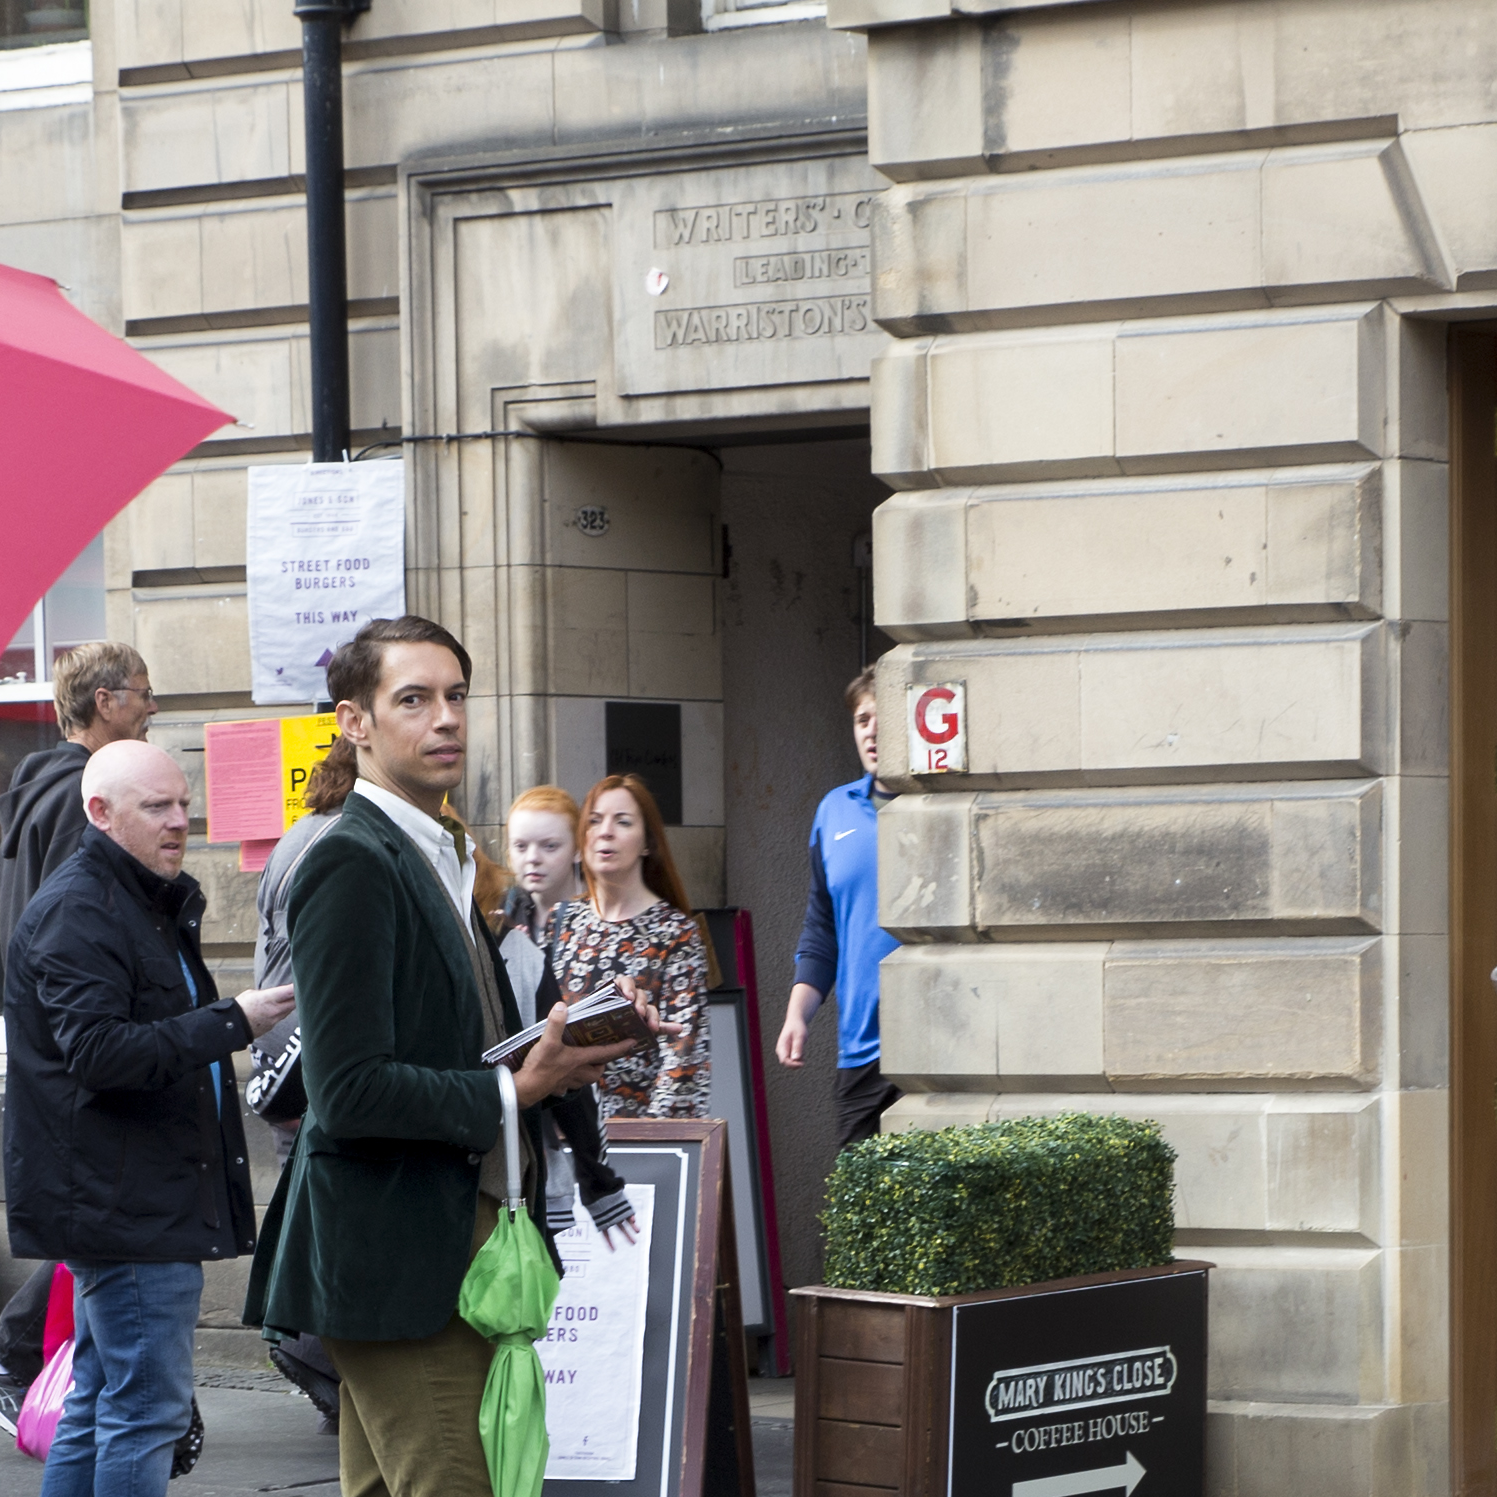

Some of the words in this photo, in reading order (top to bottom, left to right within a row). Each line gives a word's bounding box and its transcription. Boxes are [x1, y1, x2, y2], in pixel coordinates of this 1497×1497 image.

[740, 252, 848, 286] LEADING
[663, 299, 868, 347] WARRISTON'S
[581, 510, 605, 530] 323
[281, 560, 331, 573] STREET
[336, 558, 371, 571] FOOD
[295, 576, 356, 590] BURGERS
[295, 612, 325, 624] THIS
[330, 610, 358, 623] WAY
[915, 687, 959, 745] G
[928, 748, 949, 770] 12
[555, 1306, 599, 1321] FOOD
[545, 1370, 578, 1384] WAY
[997, 1376, 1048, 1410] MARY
[1053, 1367, 1106, 1401] KING'S
[1112, 1357, 1165, 1391] CLOSE
[1011, 1421, 1084, 1454] COFFEE
[1088, 1411, 1150, 1441] HOUSE
